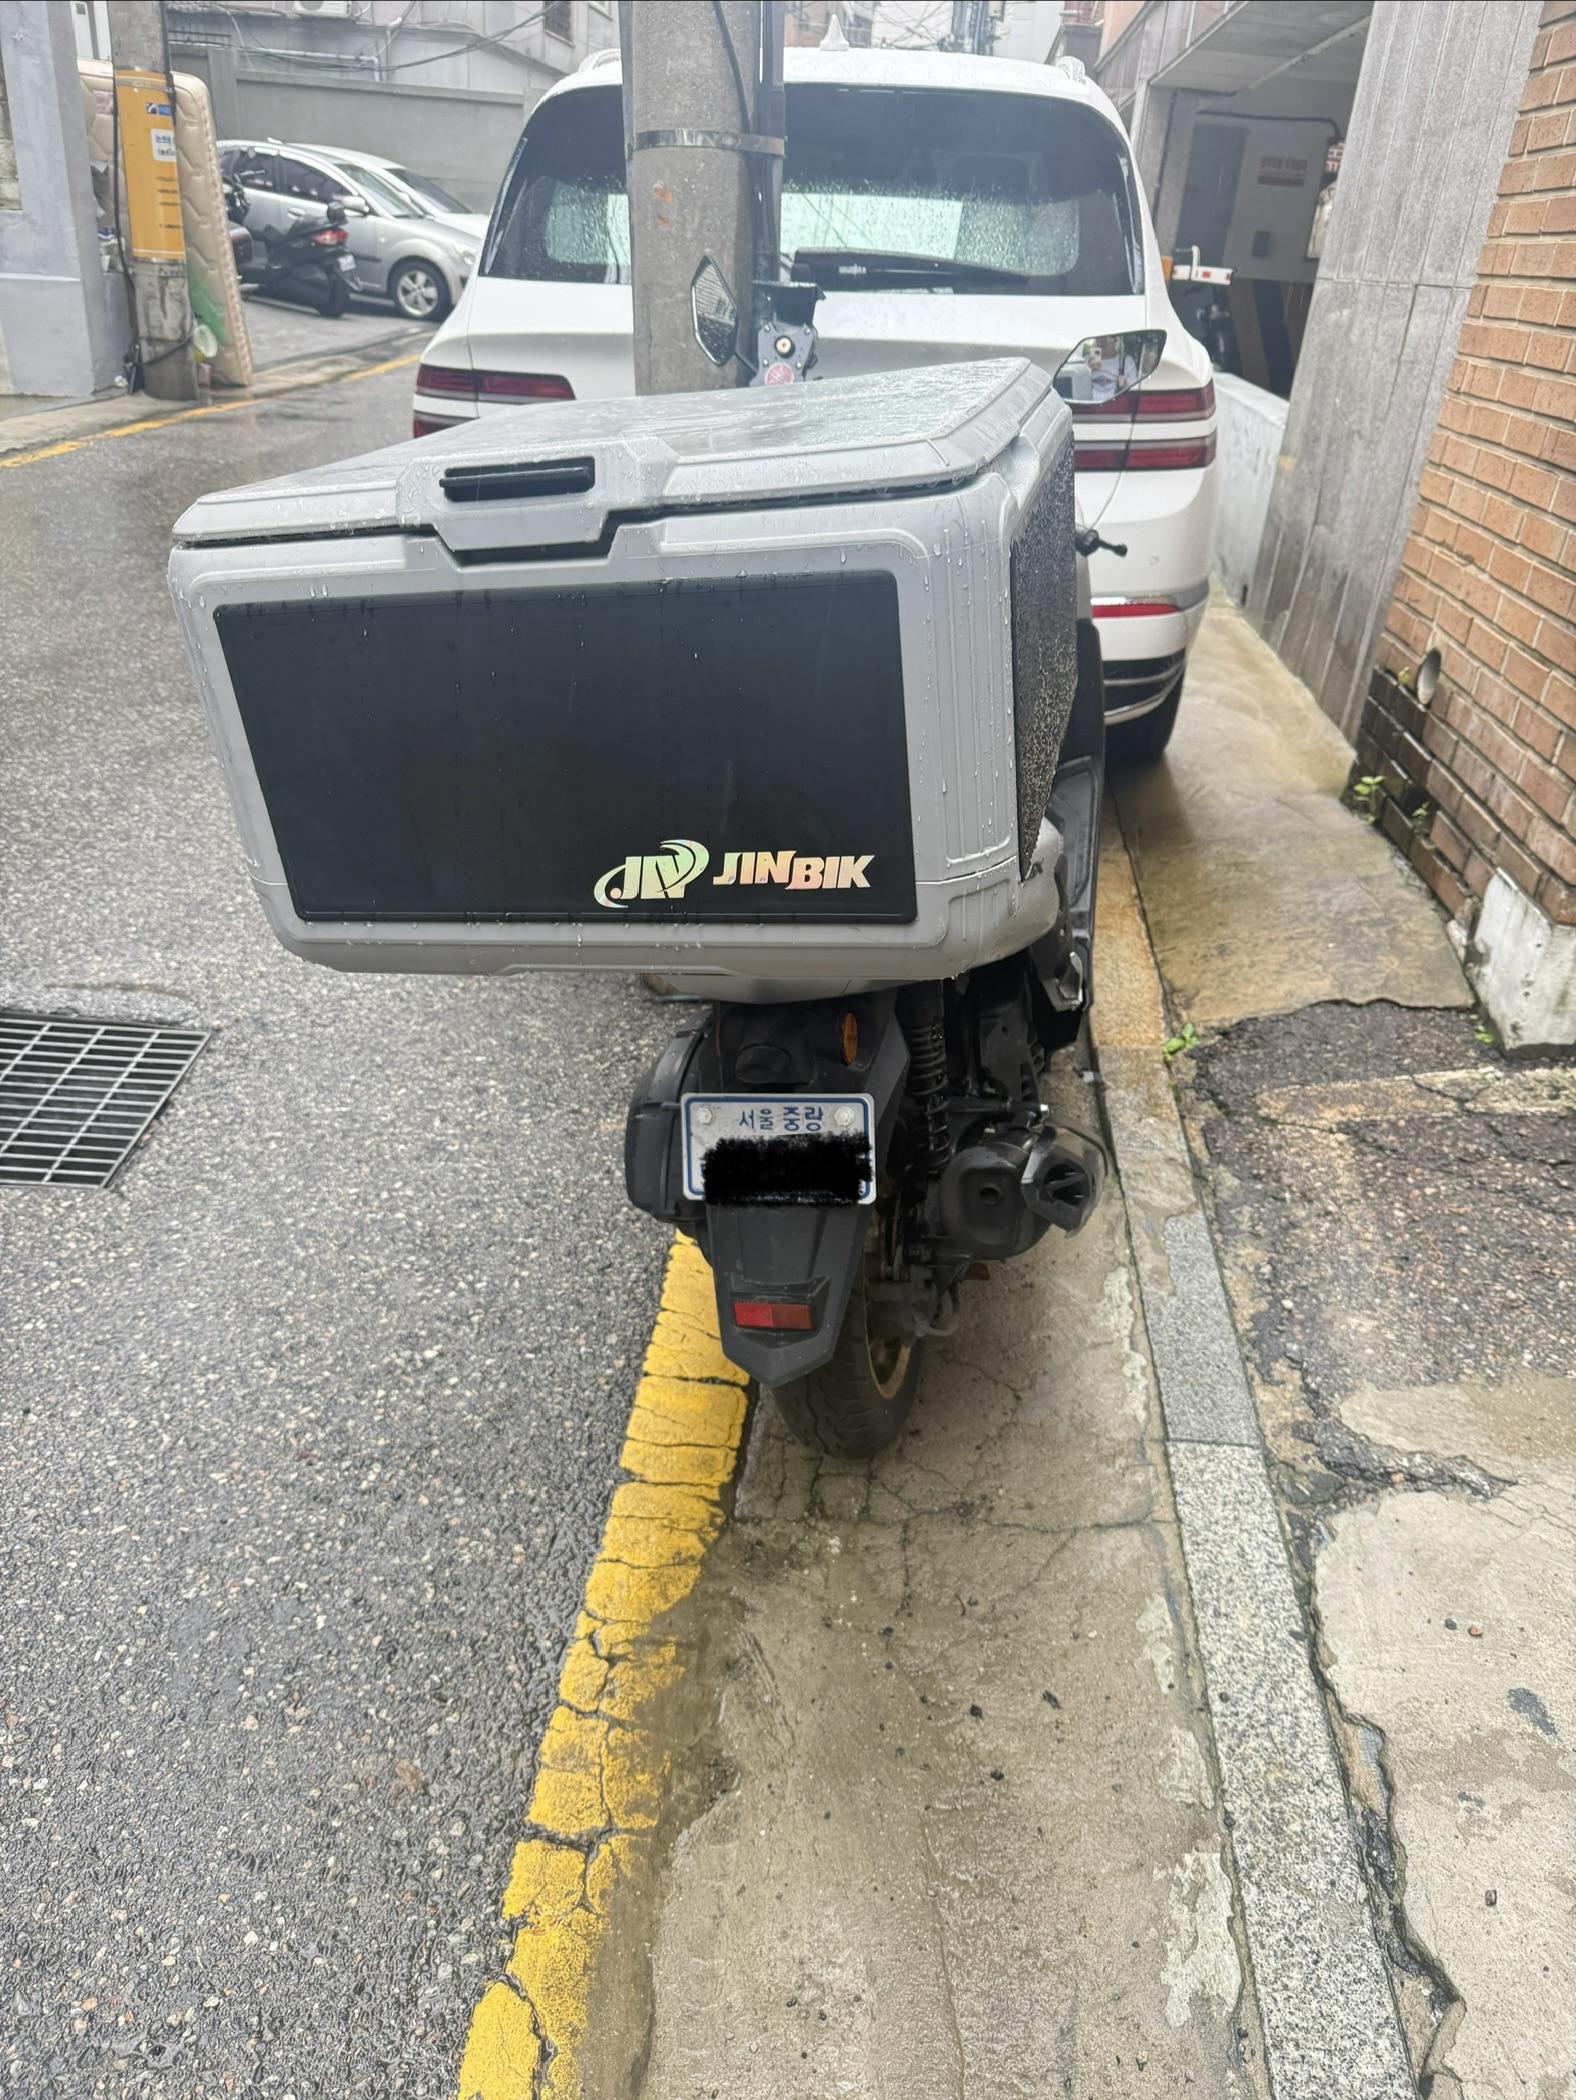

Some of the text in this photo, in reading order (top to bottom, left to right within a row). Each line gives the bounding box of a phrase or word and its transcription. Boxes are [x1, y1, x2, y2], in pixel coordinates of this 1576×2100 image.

[712, 850, 876, 890] JINBIK
[739, 1106, 824, 1132] 서울 중랑
